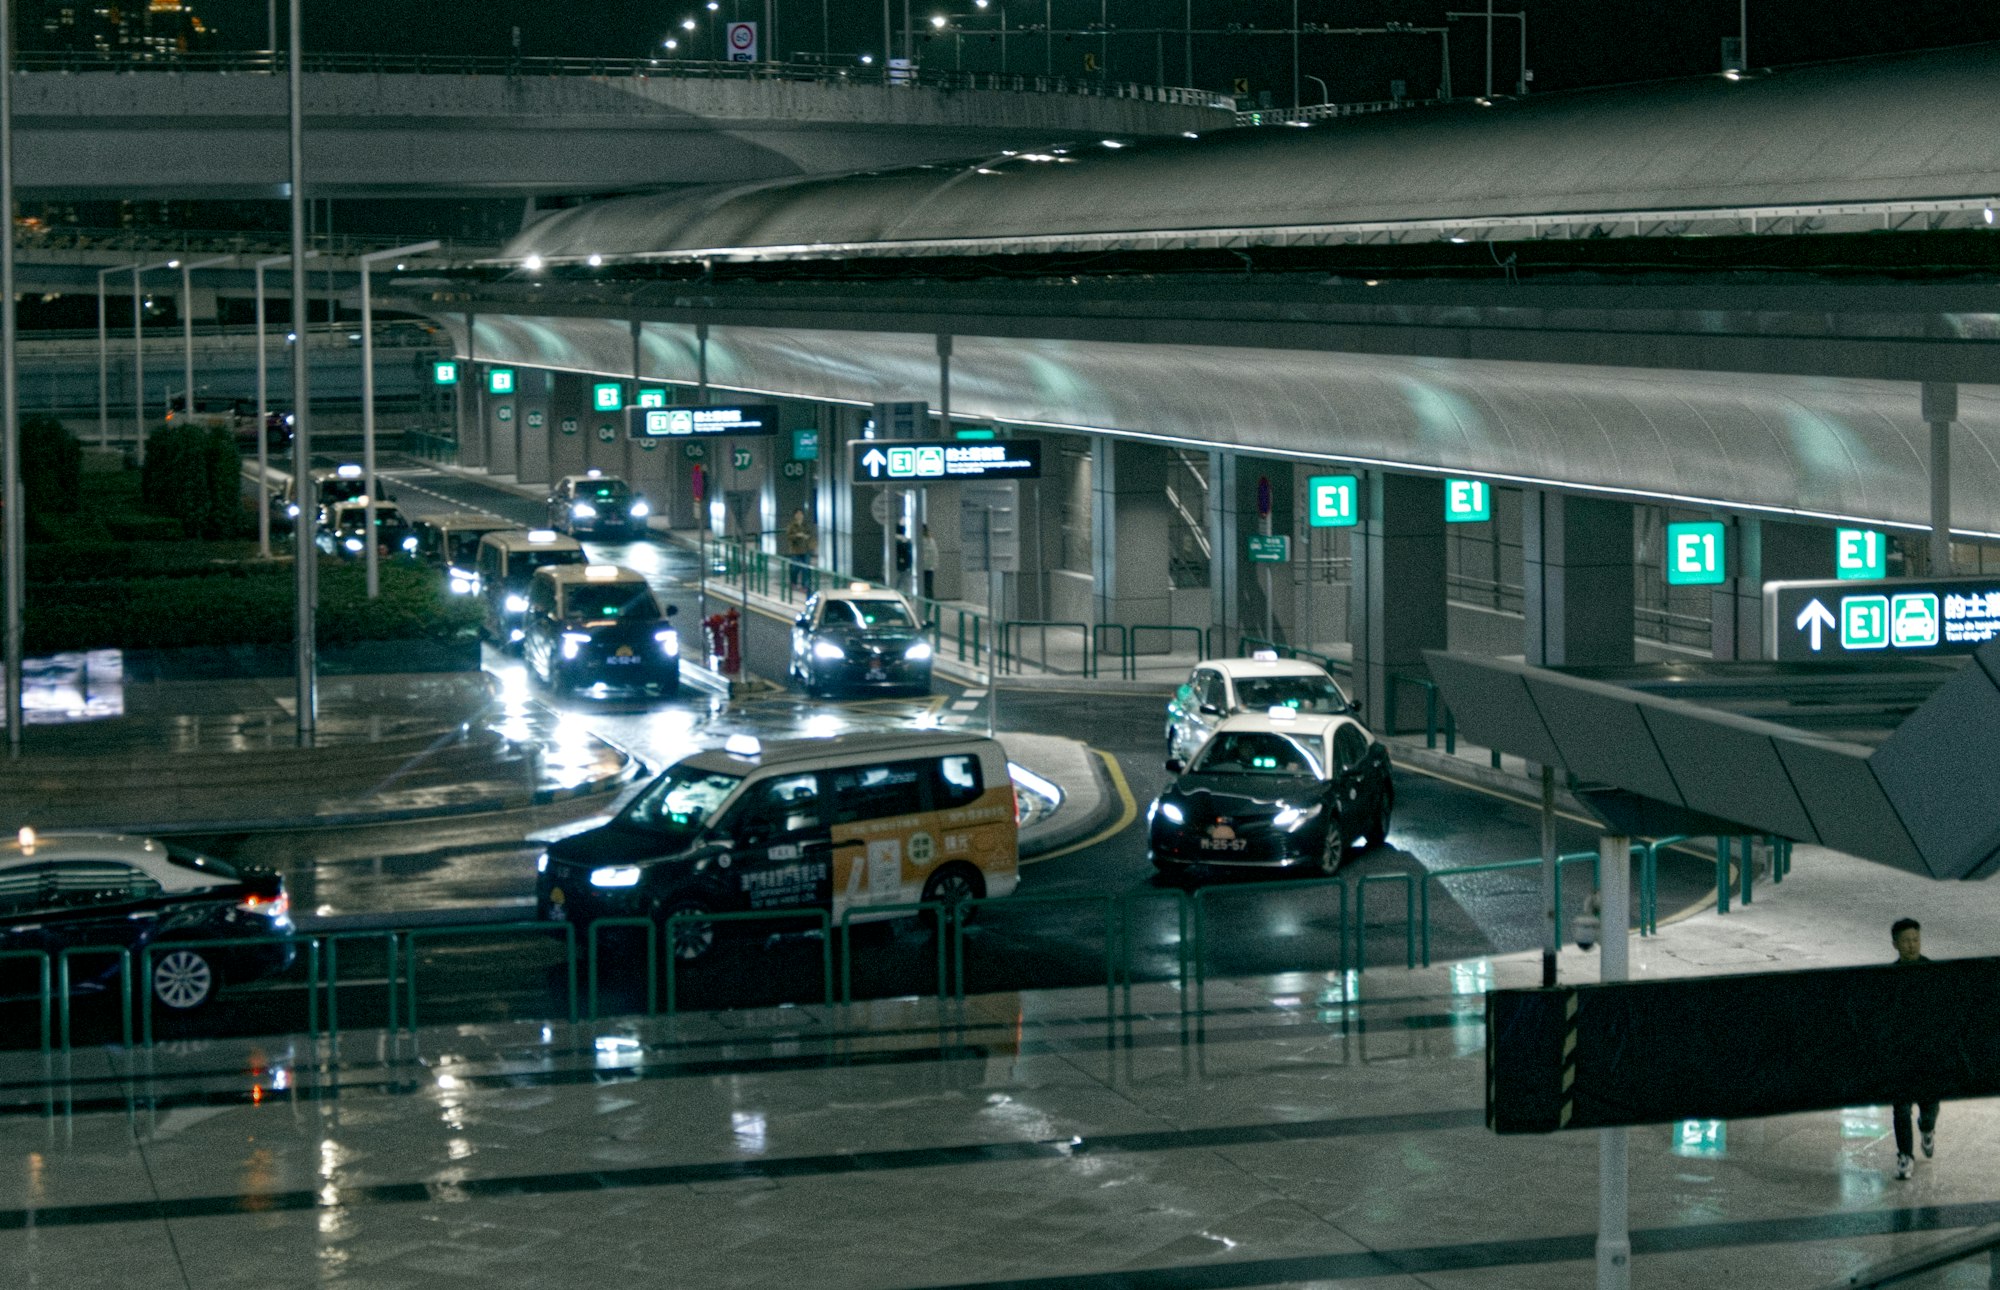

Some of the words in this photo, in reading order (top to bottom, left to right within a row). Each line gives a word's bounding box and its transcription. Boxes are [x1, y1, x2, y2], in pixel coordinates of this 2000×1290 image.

[597, 388, 618, 407] E1
[499, 408, 511, 419] 01
[527, 414, 543, 426] 02
[562, 421, 577, 432] 03
[599, 428, 614, 440] 04
[686, 445, 703, 458] 06
[785, 463, 803, 476] 08
[892, 453, 912, 472] E1
[1317, 485, 1349, 518] E1
[1451, 481, 1483, 513] E1
[1677, 533, 1715, 573] E1
[1839, 530, 1877, 569] E1
[1849, 606, 1881, 639] E1
